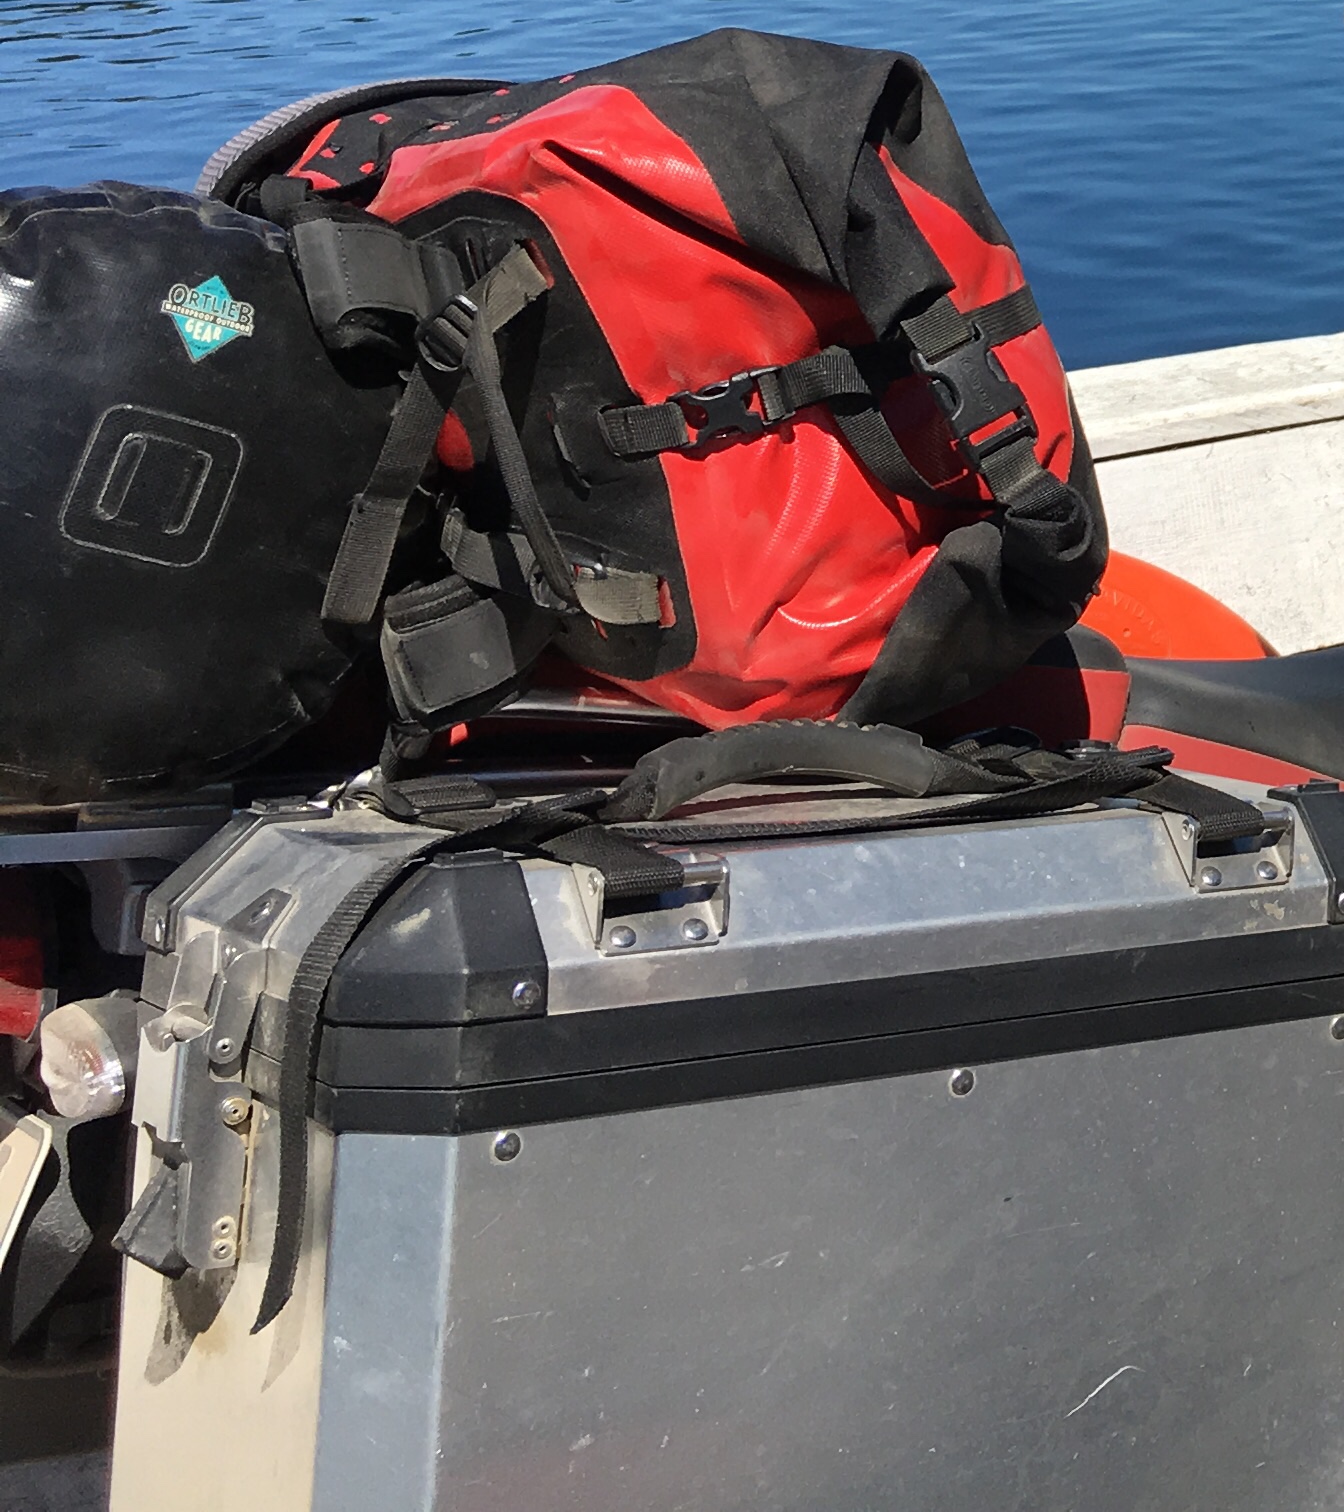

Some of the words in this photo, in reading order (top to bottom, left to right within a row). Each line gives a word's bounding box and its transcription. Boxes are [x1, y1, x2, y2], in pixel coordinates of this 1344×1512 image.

[165, 303, 215, 321] WATERPROOF
[216, 317, 250, 333] OUTDOOR
[171, 283, 252, 325] ORTLIEB
[185, 318, 222, 343] GEAR
